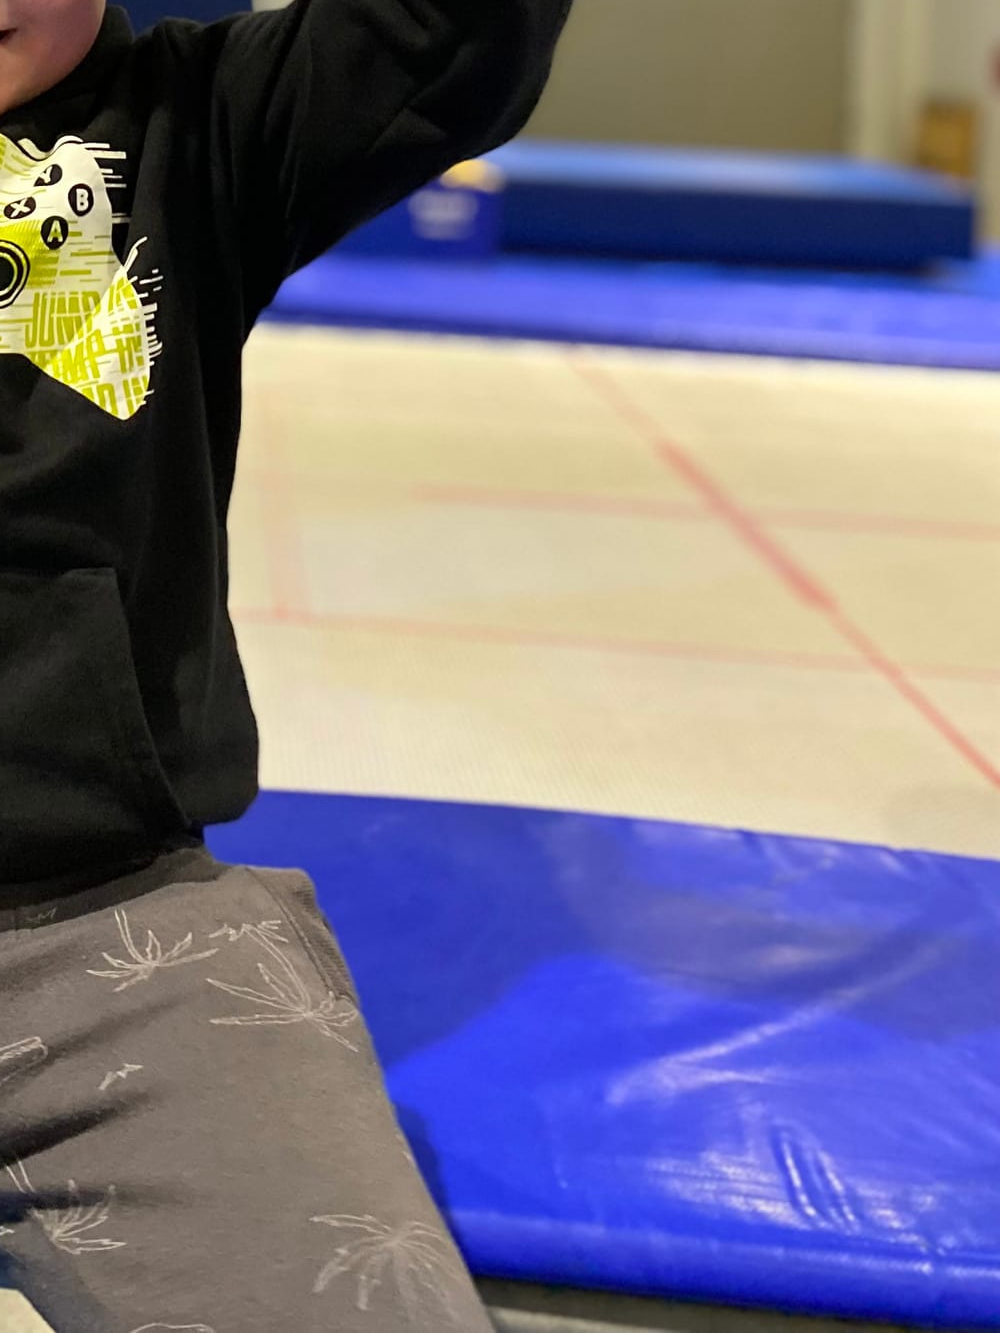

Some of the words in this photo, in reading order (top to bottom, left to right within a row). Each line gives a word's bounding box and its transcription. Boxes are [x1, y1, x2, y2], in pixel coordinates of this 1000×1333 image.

[10, 197, 31, 218] X
[75, 188, 89, 211] B
[47, 219, 63, 243] A
